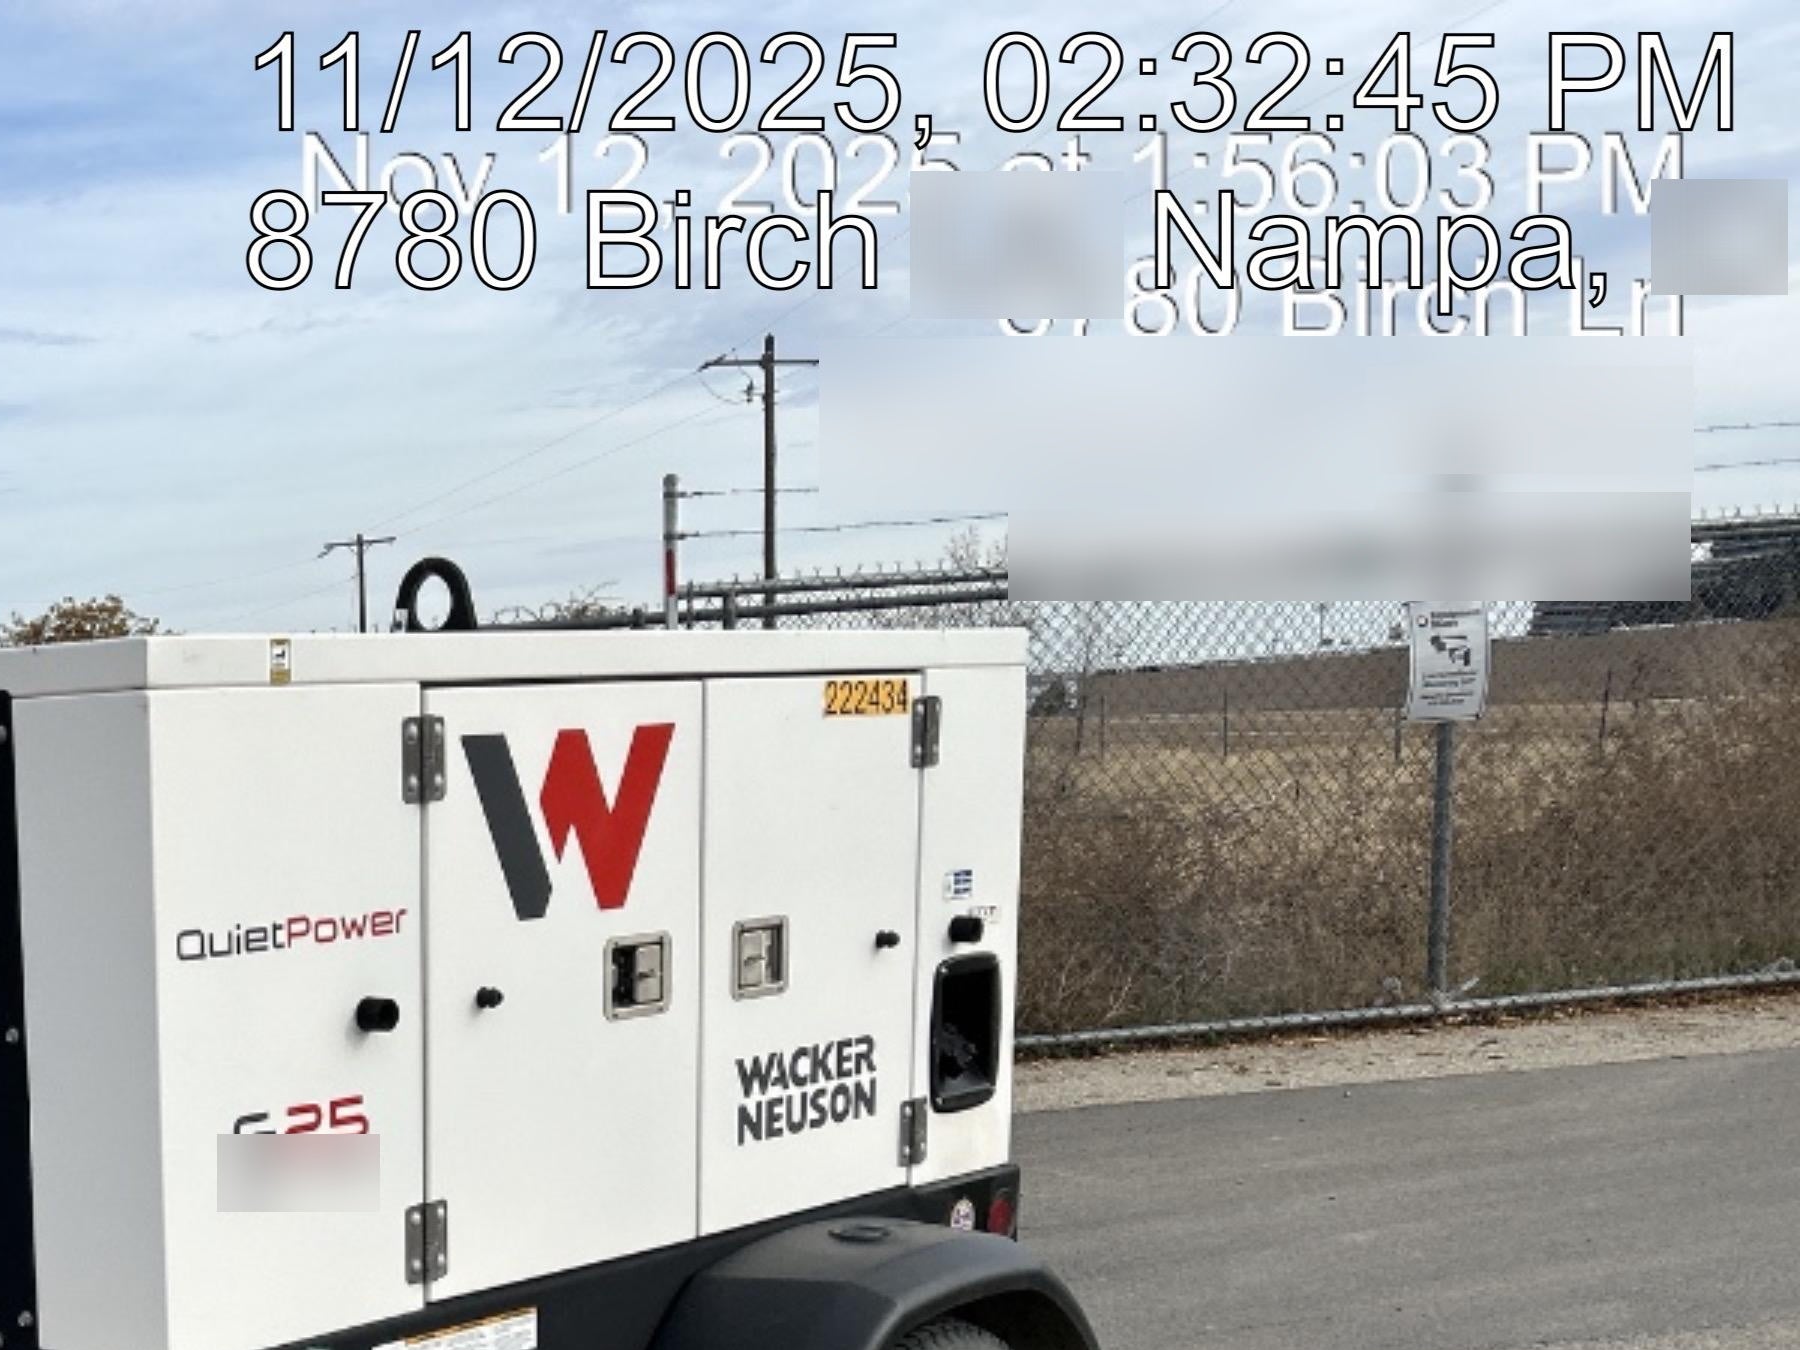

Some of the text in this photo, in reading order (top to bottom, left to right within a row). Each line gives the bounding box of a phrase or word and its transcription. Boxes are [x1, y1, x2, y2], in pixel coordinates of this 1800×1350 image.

[824, 679, 907, 715] 222434
[176, 908, 408, 962] QuietPower
[734, 1034, 877, 1098] WACKER
[737, 1076, 877, 1147] NEUSON
